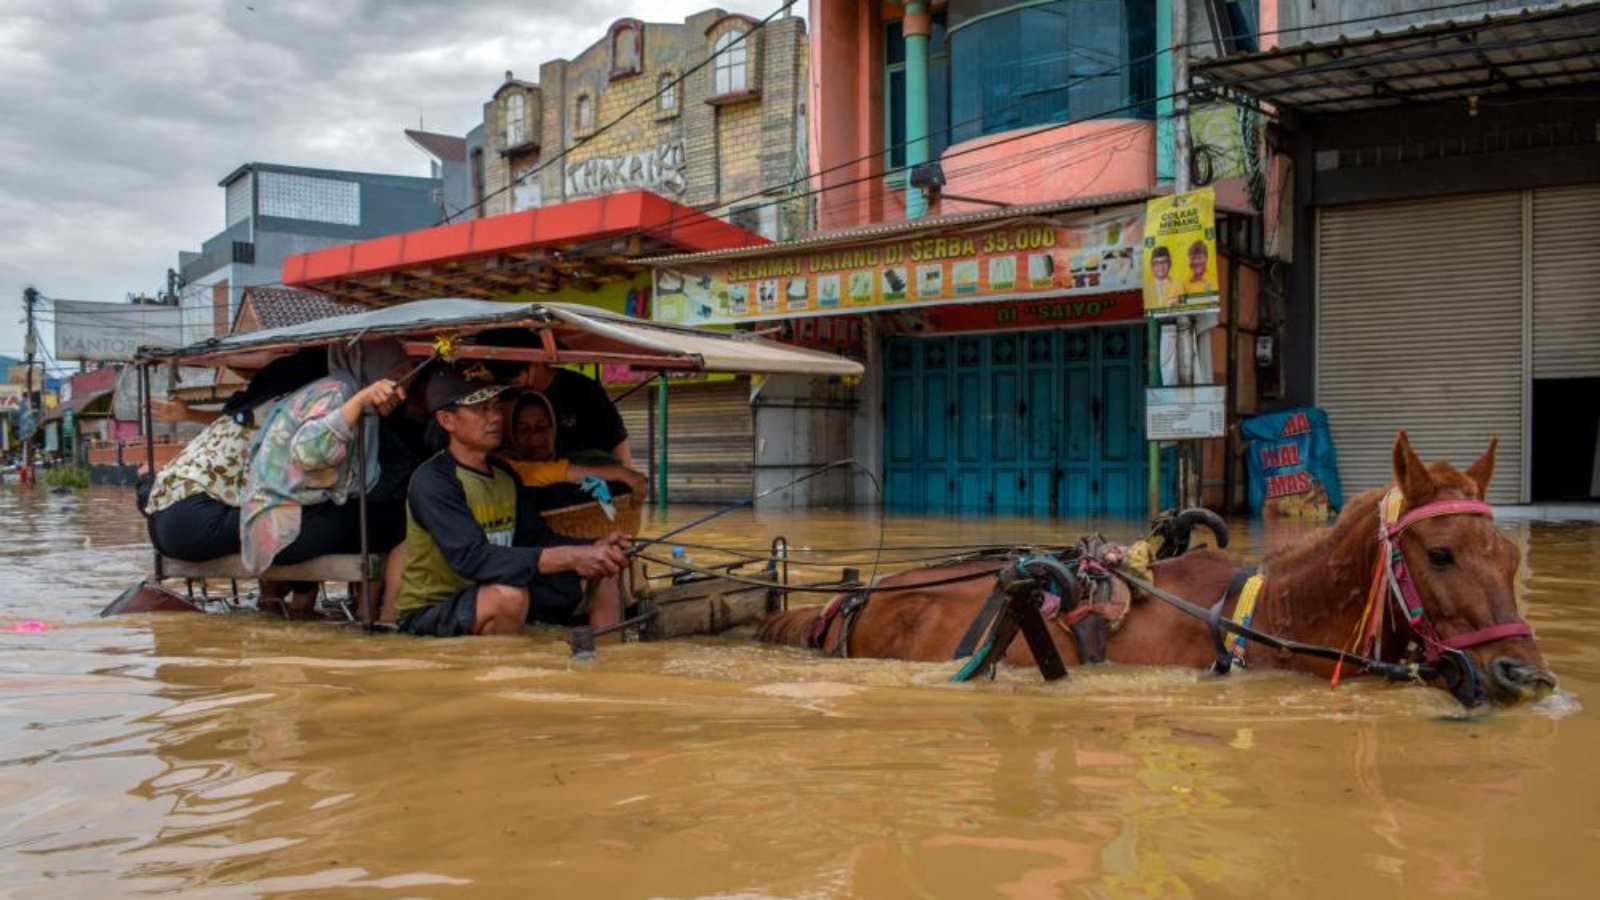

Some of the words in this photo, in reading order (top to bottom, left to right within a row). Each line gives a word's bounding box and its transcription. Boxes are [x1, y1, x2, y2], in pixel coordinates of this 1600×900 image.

[1161, 207, 1198, 221] GOLKAR
[1160, 215, 1199, 229] MENANG
[729, 258, 801, 281] SELAMAT
[810, 248, 879, 273] DATANG
[885, 242, 904, 263] DI
[910, 236, 976, 261] SERBA
[983, 226, 1056, 253] 35.000
[997, 308, 1017, 323] DI
